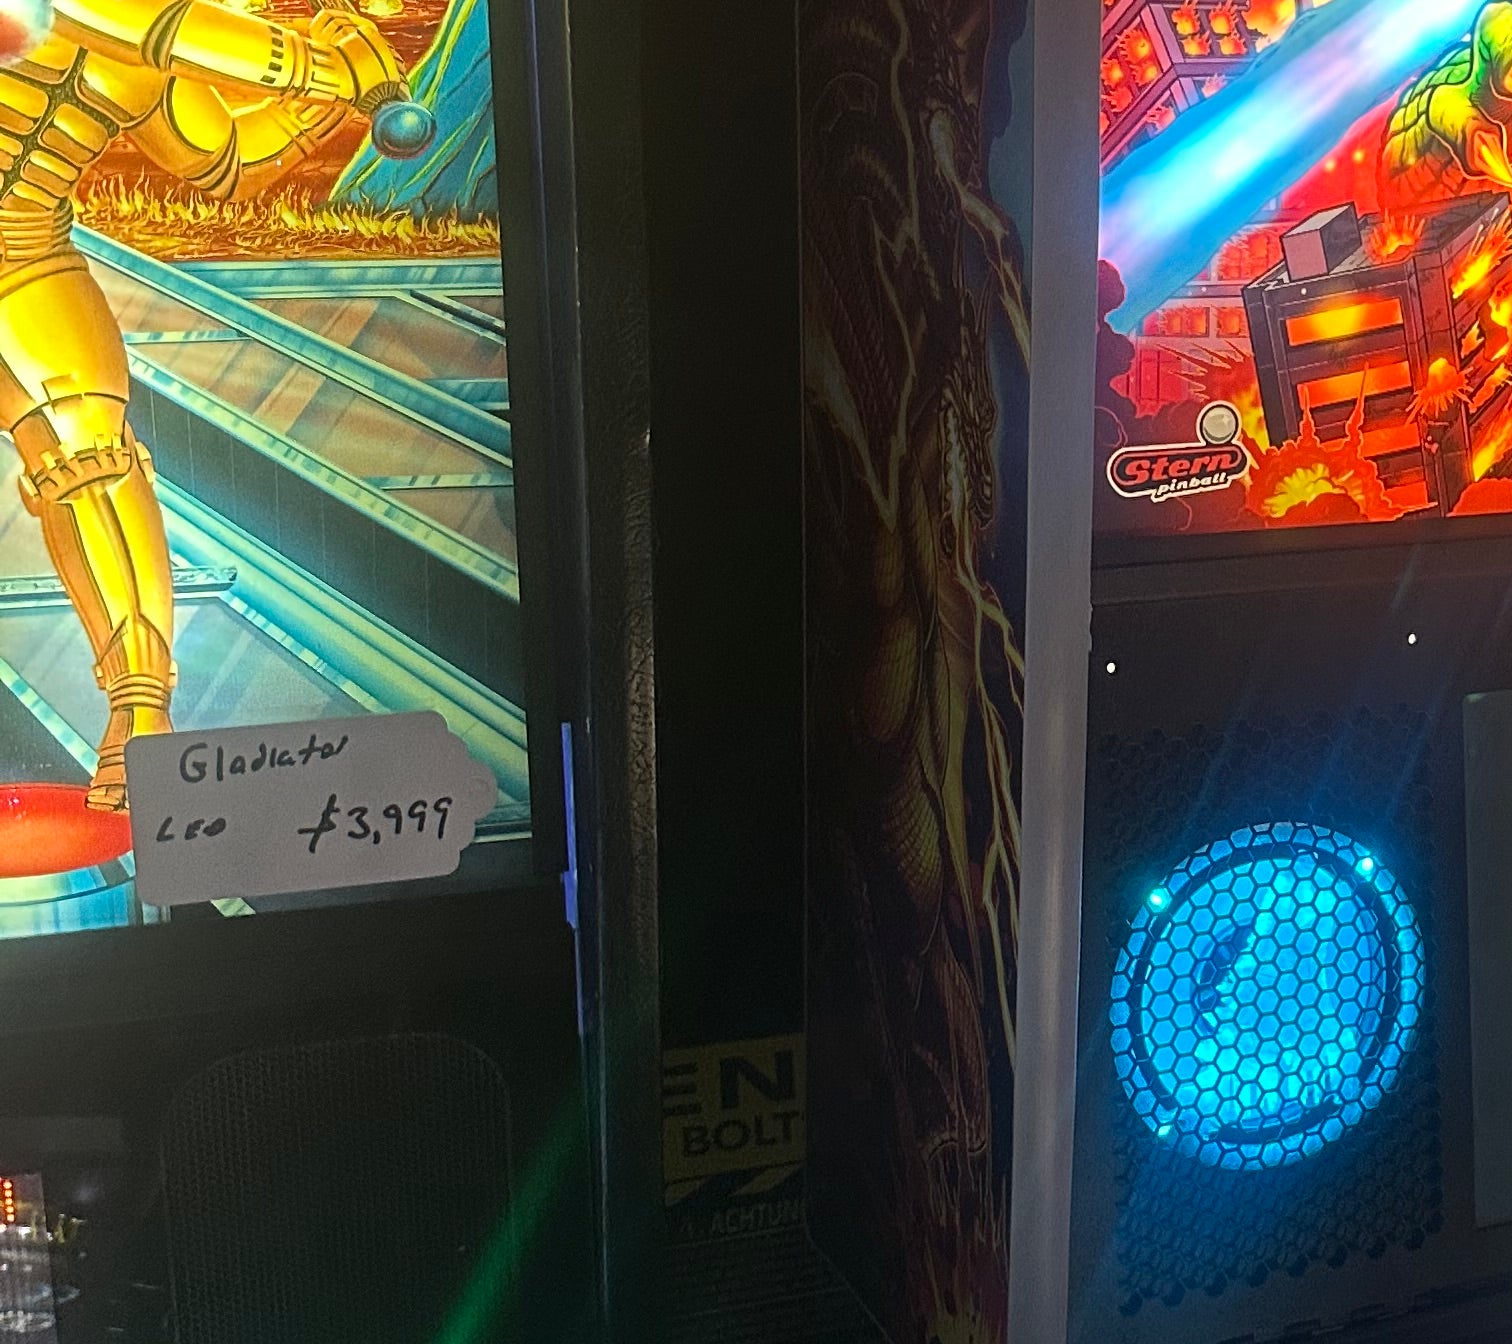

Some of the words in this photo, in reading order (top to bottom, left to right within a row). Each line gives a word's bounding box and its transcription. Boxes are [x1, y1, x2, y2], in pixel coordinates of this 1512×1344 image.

[1124, 452, 1235, 486] Stern
[1156, 471, 1228, 496] pinball
[179, 734, 350, 784] Gladiator
[297, 792, 455, 855] $3,999
[708, 1198, 807, 1236] ACHTUN
